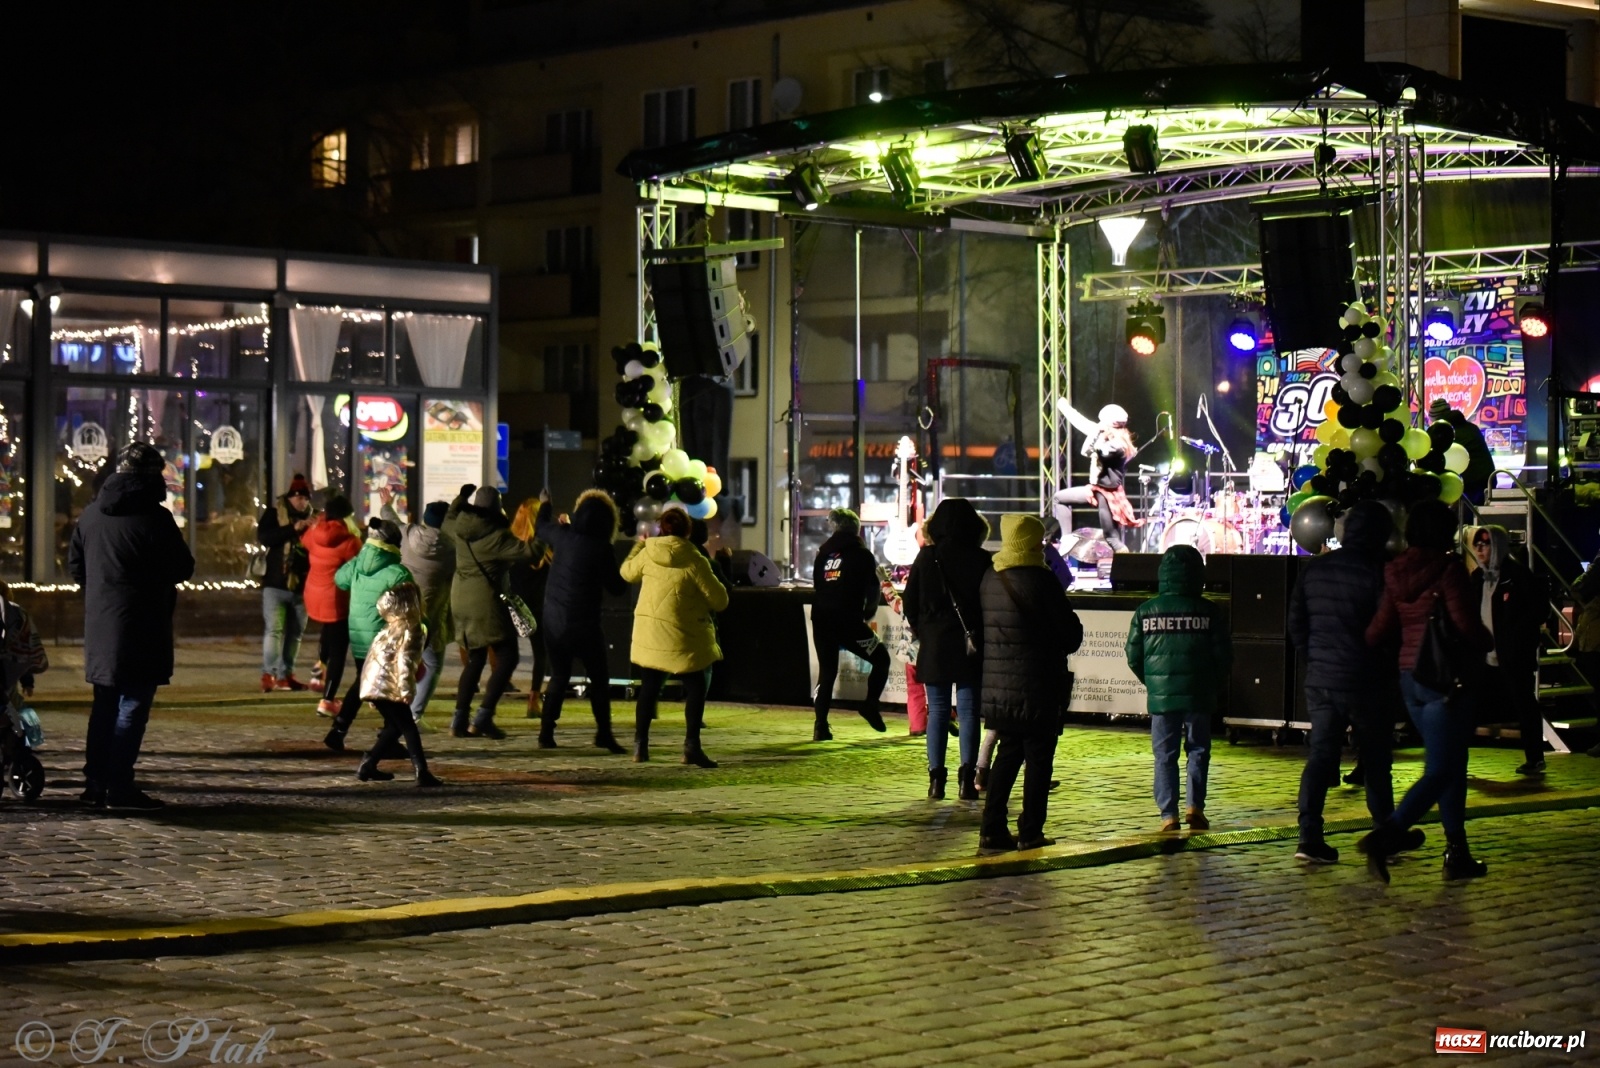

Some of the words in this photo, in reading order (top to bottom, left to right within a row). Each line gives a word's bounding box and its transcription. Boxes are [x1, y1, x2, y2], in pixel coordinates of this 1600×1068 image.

[1285, 373, 1312, 383] 2022
[1272, 375, 1340, 436] 30
[1302, 428, 1319, 440] FI
[823, 557, 842, 572] 30
[1142, 616, 1211, 632] BENETTON
[1095, 631, 1128, 640] EUROPEJS
[1089, 640, 1127, 649] REGIONÁLN
[1091, 650, 1124, 658] ROZWOJU
[1088, 678, 1109, 686] miasta
[1076, 685, 1107, 694] Funduszu
[1107, 686, 1137, 696] Rozwoju
